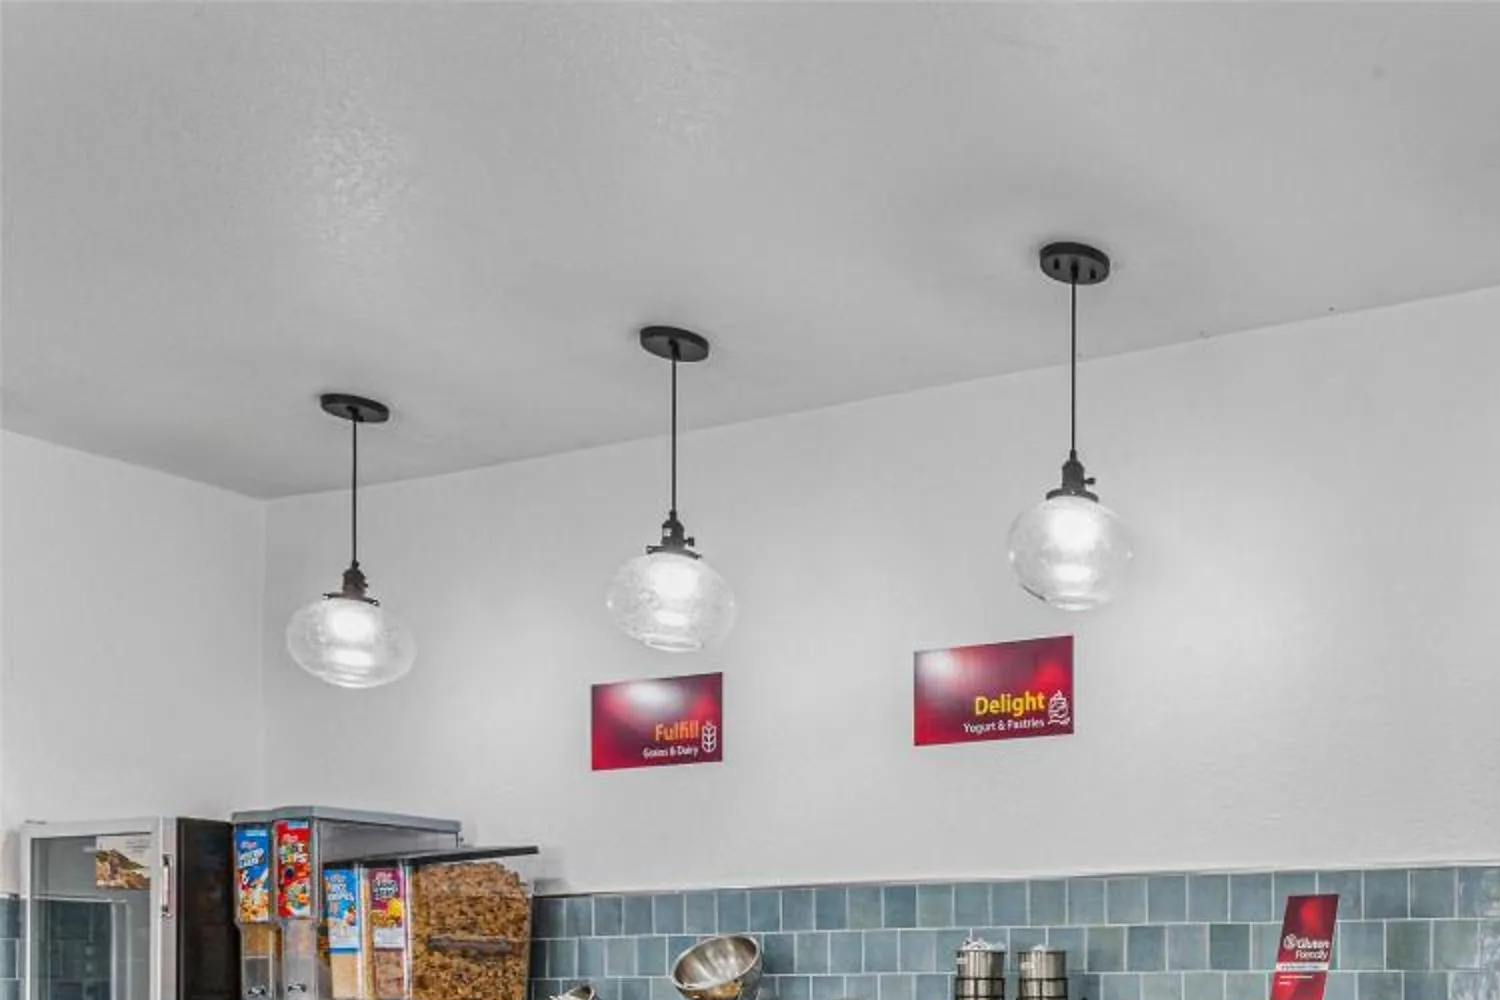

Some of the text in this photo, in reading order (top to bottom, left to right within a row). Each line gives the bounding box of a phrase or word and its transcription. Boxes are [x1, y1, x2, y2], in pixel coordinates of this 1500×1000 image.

[975, 690, 1046, 717] Delight
[655, 719, 699, 742] Fulfill
[963, 721, 998, 736] Yogurt
